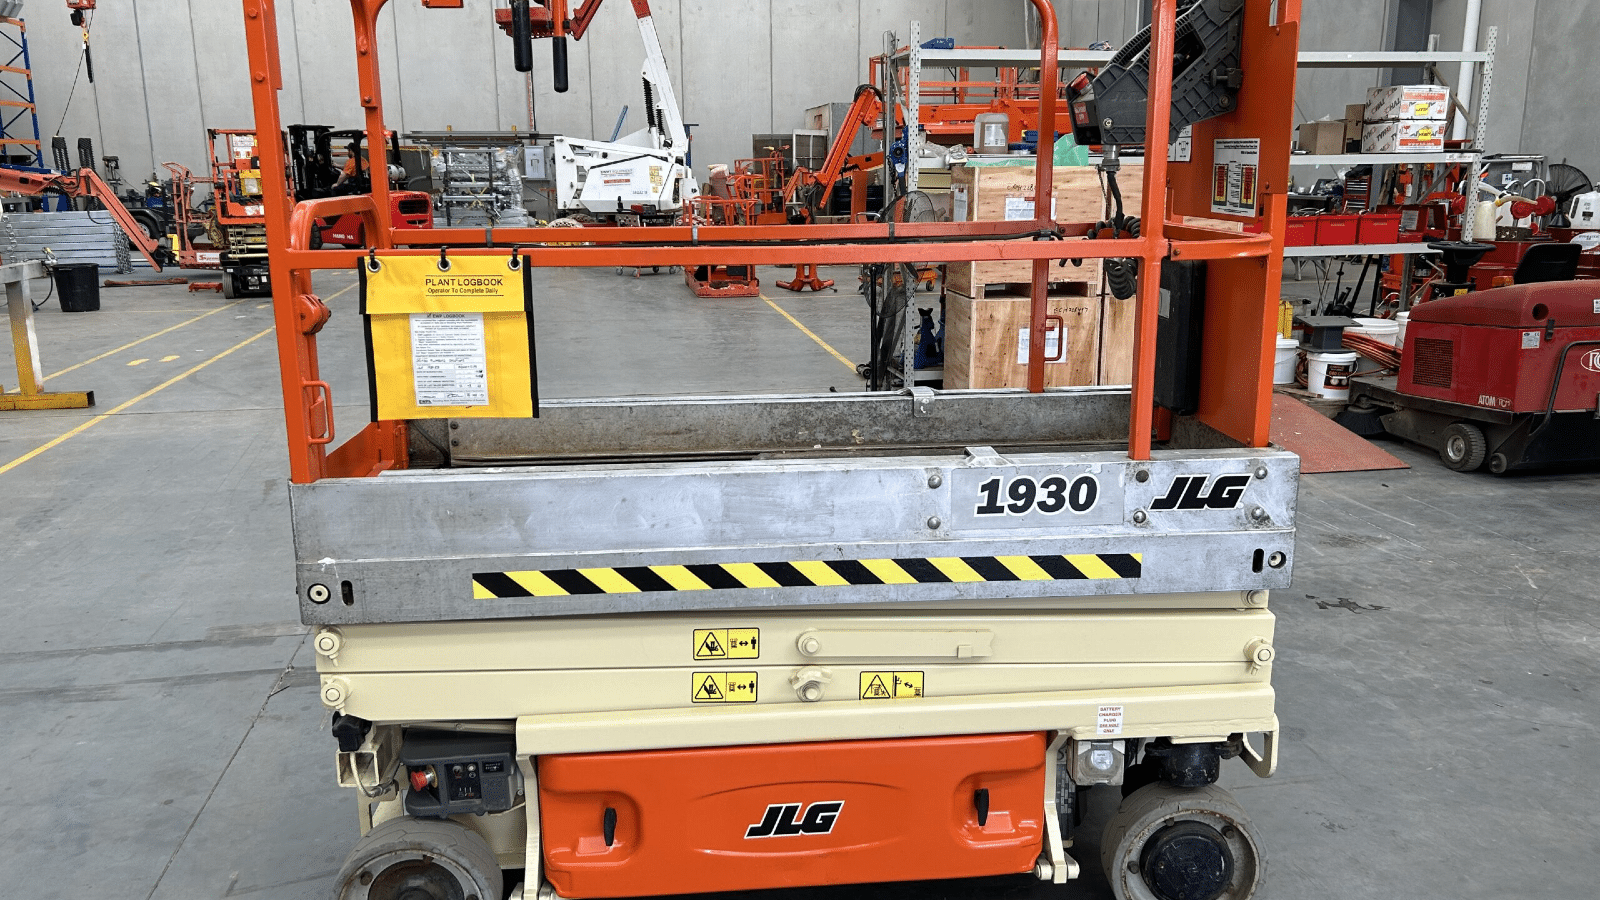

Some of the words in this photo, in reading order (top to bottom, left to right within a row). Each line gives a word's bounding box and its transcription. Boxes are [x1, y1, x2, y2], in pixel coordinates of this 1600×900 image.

[425, 278, 456, 286] PLANT
[457, 278, 504, 286] LOGBOOK
[1478, 395, 1496, 406] ATOM
[975, 474, 1099, 516] 1930
[1150, 474, 1251, 510] JLG
[744, 800, 845, 839] JLG
